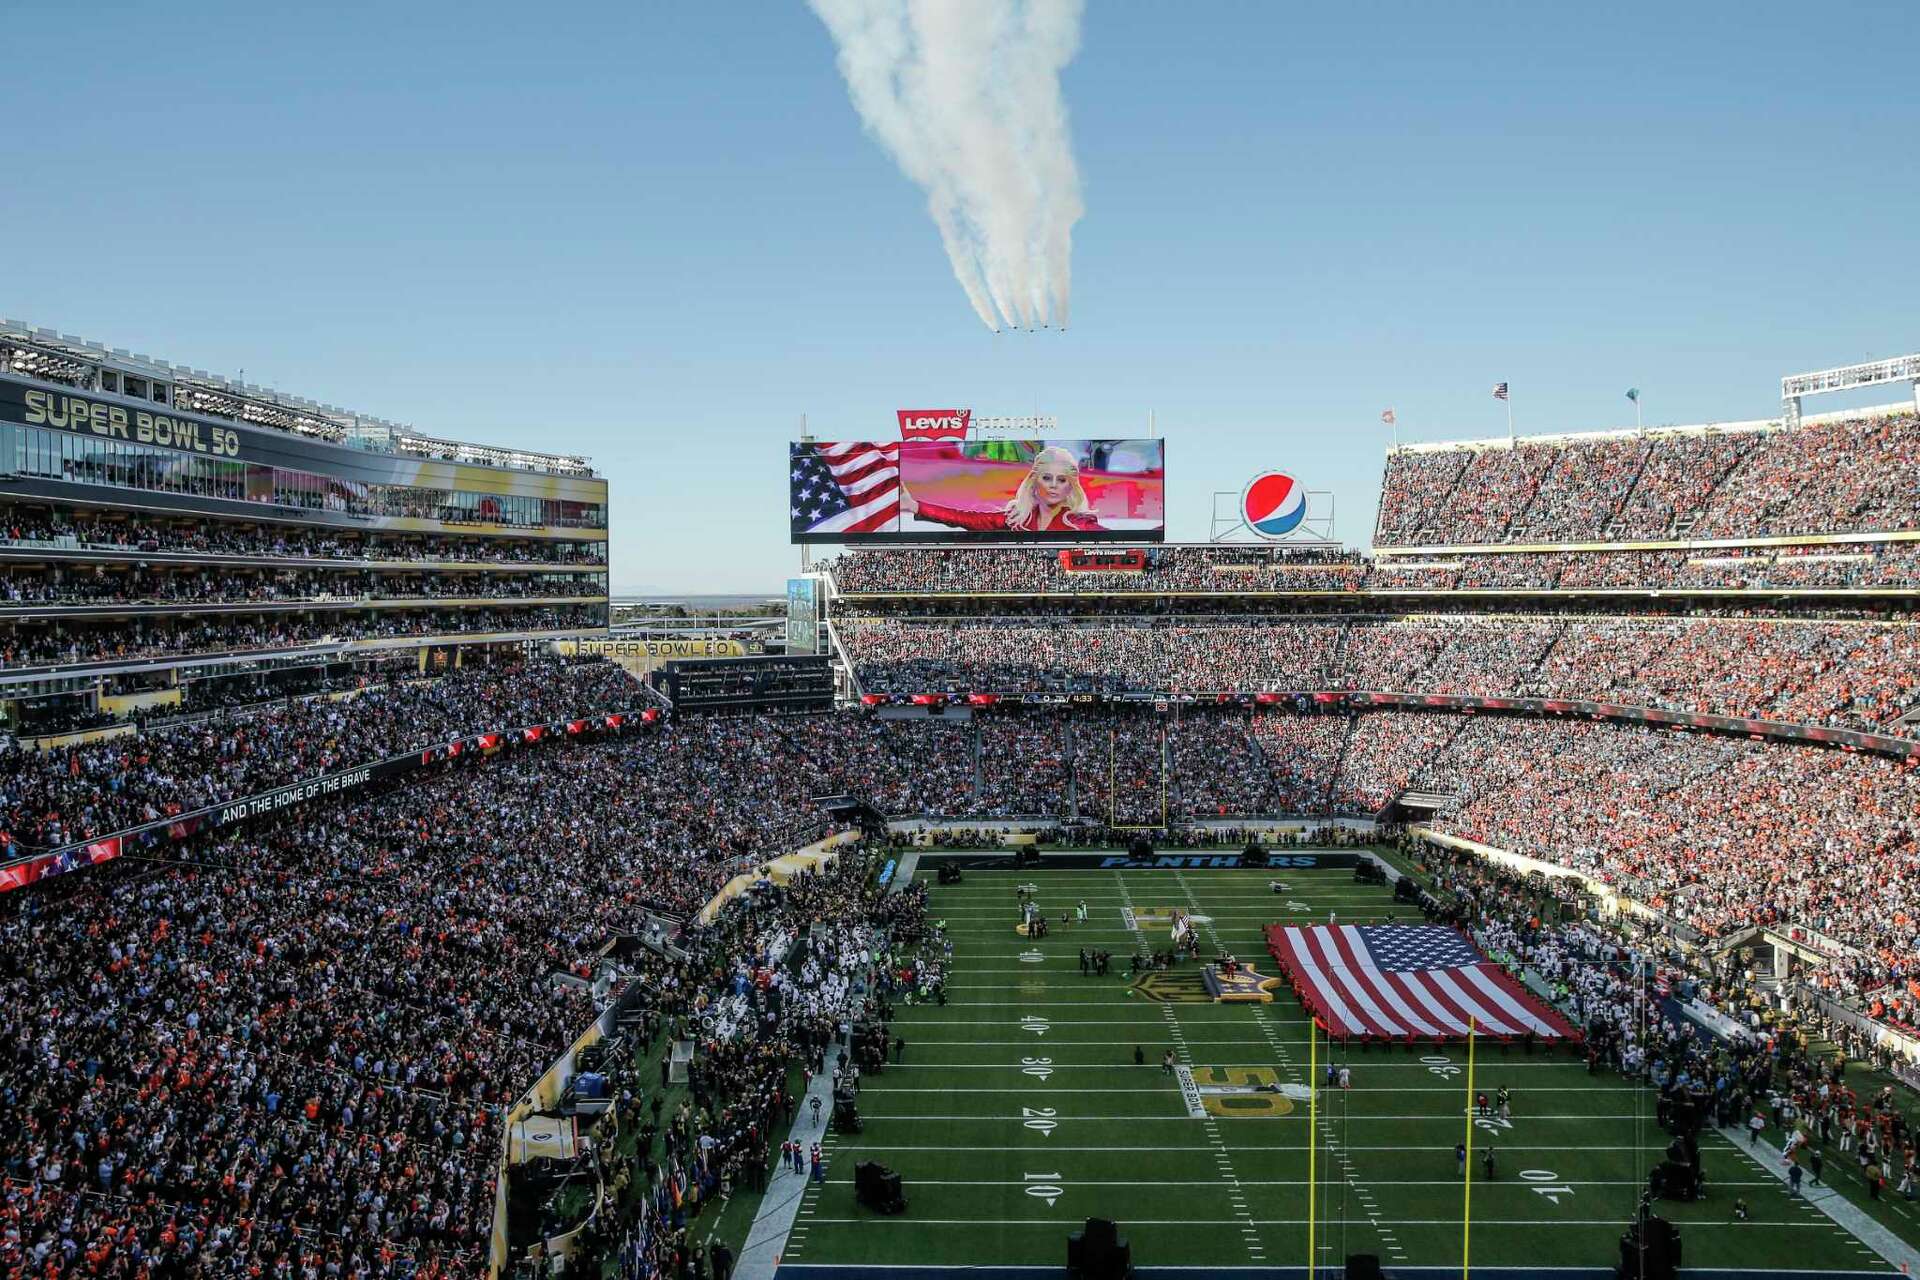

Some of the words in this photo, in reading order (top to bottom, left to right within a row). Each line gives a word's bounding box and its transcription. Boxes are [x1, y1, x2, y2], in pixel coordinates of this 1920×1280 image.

[25, 390, 129, 439] SUPER
[136, 412, 207, 451] BOWL
[212, 427, 240, 457] 50
[1073, 695, 1093, 703] 4:33
[222, 803, 247, 824] AND
[250, 797, 272, 815] THE
[274, 788, 303, 808] HOME
[306, 783, 319, 798] OF
[321, 777, 340, 794] THE
[341, 769, 370, 788] BRAVE
[1100, 857, 1317, 867] PNTHRS
[1020, 1015, 1051, 1031] 40
[1021, 1056, 1054, 1075] 30
[1419, 1056, 1462, 1074] 30
[1022, 1107, 1058, 1130] 20
[1024, 1172, 1064, 1197] 10
[1518, 1169, 1575, 1195] 10
